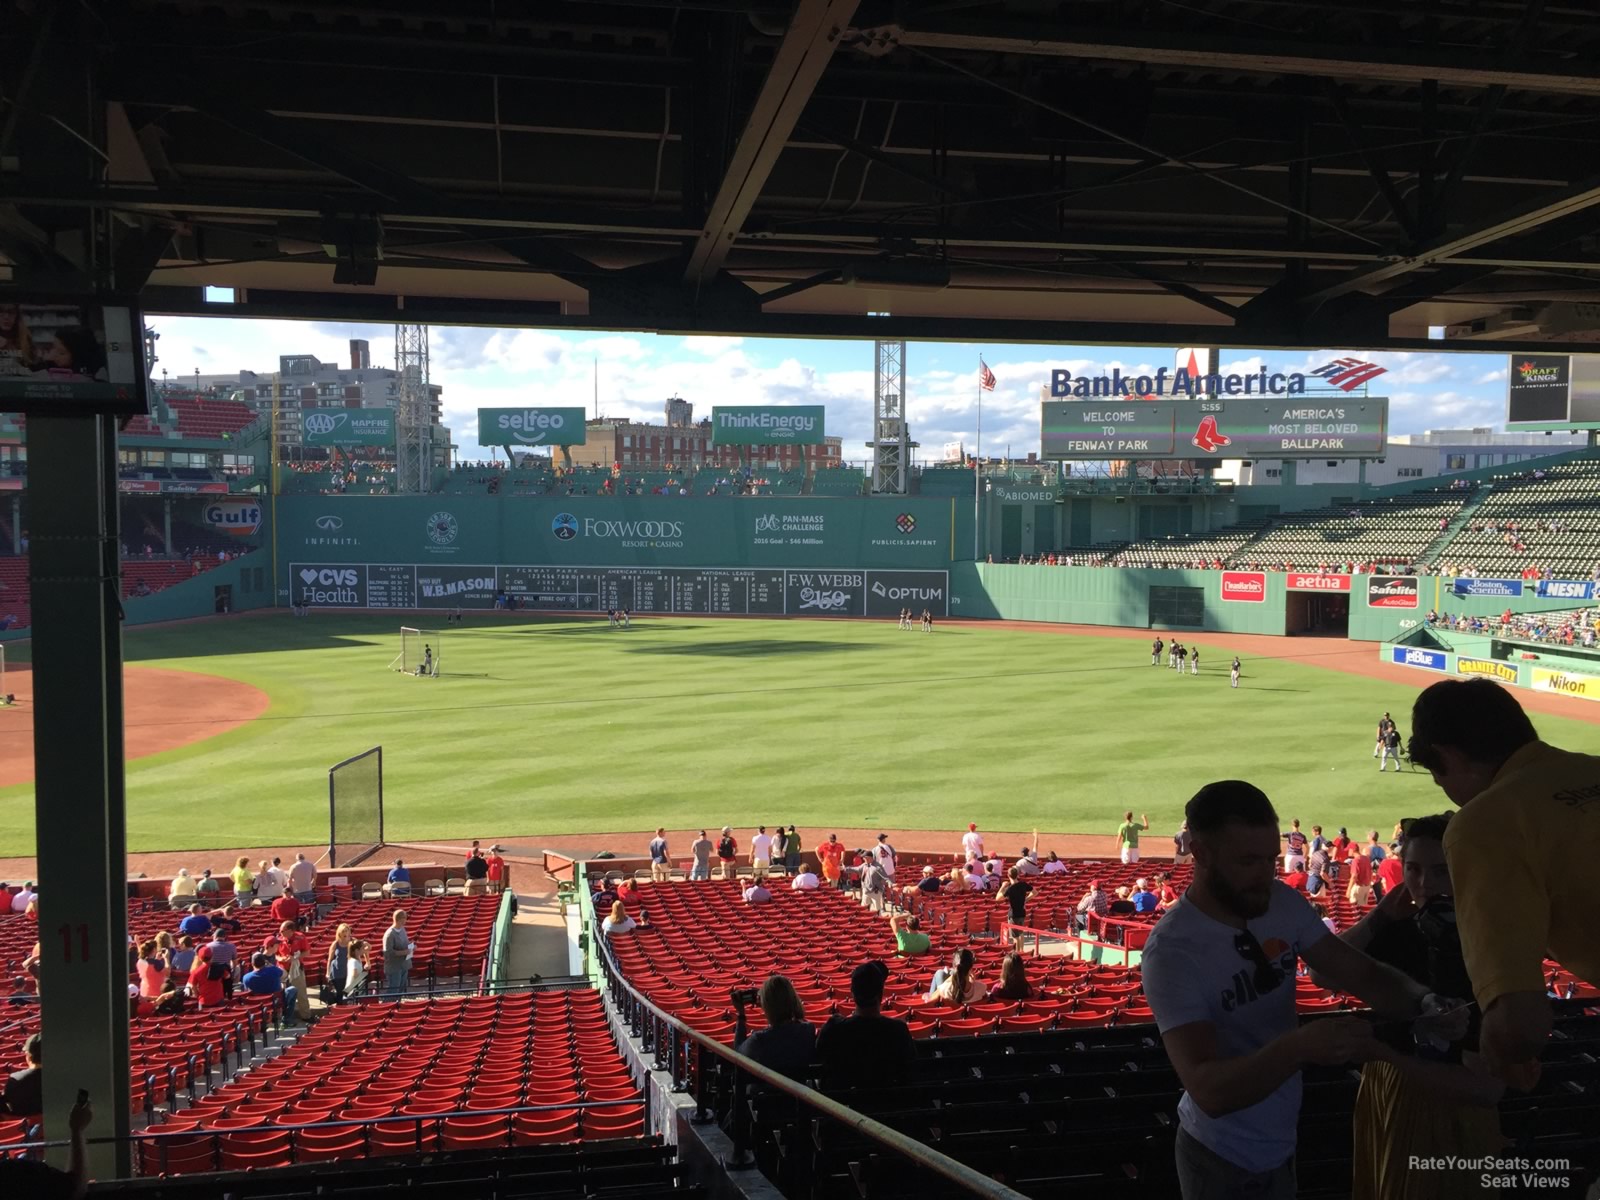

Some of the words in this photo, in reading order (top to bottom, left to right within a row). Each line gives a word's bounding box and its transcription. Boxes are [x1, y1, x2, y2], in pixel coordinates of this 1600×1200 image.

[1052, 368, 1129, 398] Bank
[1136, 367, 1168, 397] of
[1170, 366, 1305, 396] America
[1201, 403, 1221, 411] 5:55
[1083, 412, 1135, 422] WELCOME
[1282, 408, 1345, 420] AMERICA'S
[718, 412, 814, 431] ThinkEnergy
[1102, 426, 1115, 436] TO
[1268, 424, 1300, 434] MOST
[1304, 424, 1358, 434] BELOVED
[1068, 440, 1114, 450] FENWAY
[1118, 440, 1148, 450] PARK
[1281, 438, 1344, 449] BALLPARK
[1004, 492, 1052, 500] ABIOMED
[208, 506, 258, 523] Gulf
[584, 518, 682, 538] FOXWOODS
[318, 568, 358, 586] CVS
[788, 574, 814, 587] F.W.
[818, 574, 862, 587] WEBB
[1296, 576, 1340, 589] aetna
[1369, 585, 1416, 595] Safelite
[1467, 585, 1513, 595] Scientific
[1473, 580, 1503, 588] Boston
[1546, 582, 1586, 597] NESN
[302, 586, 358, 603] Health
[814, 590, 846, 609] 150
[888, 588, 942, 600] OPTUM
[1400, 619, 1416, 628] 420
[1405, 649, 1432, 665] jetBlue
[1458, 659, 1496, 674] GRANITE
[1497, 664, 1517, 682] CITY
[1549, 674, 1586, 693] Nikon
[58, 923, 89, 962] 11
